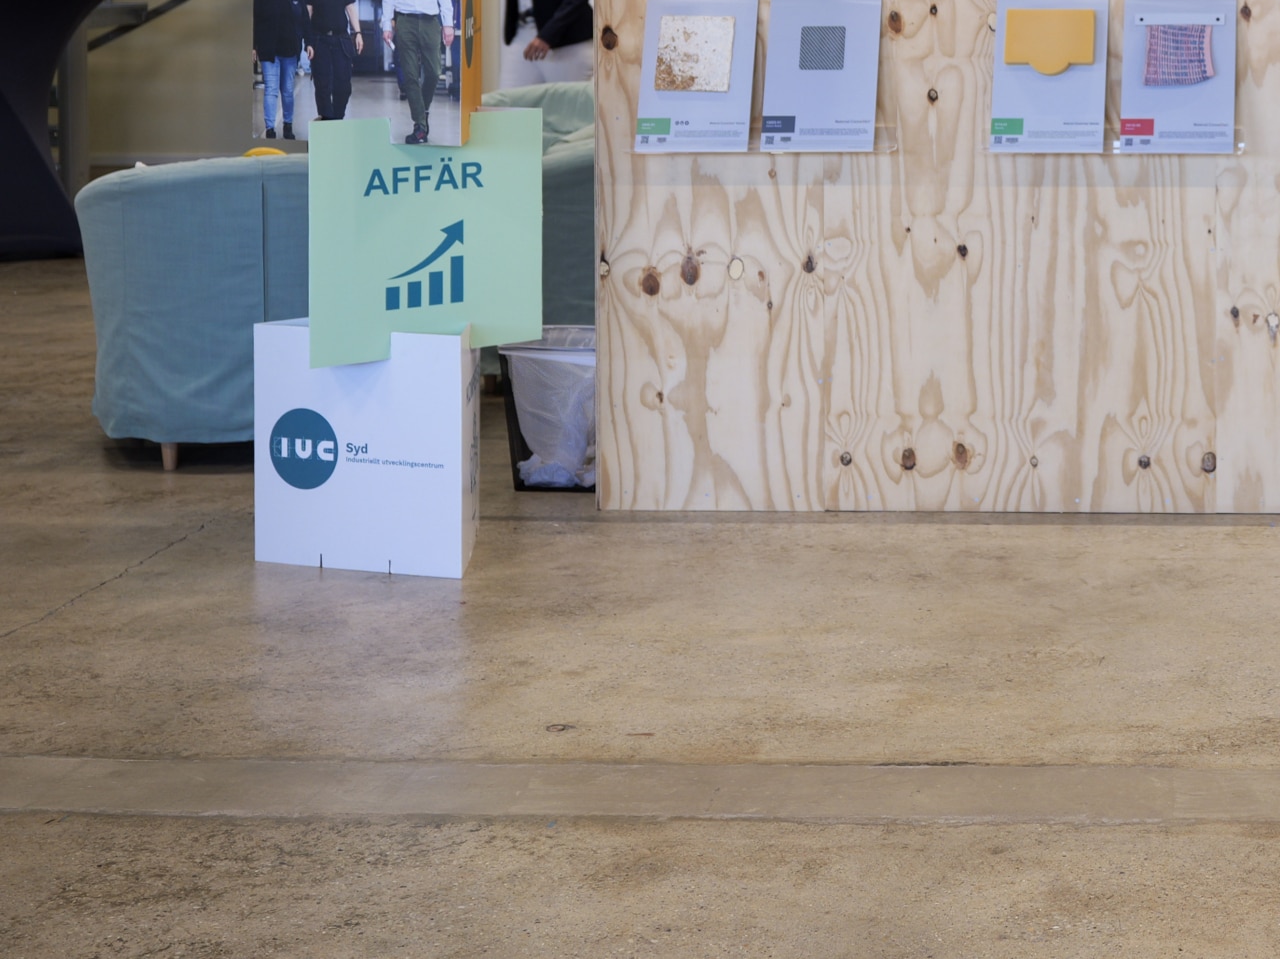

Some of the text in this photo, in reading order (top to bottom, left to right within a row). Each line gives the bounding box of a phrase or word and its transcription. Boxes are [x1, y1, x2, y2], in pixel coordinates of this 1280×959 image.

[363, 157, 484, 197] AFFÄR
[281, 437, 335, 461] IUC
[346, 442, 368, 456] Syd
[345, 457, 444, 469] Industriellt utvecklingscentrum
